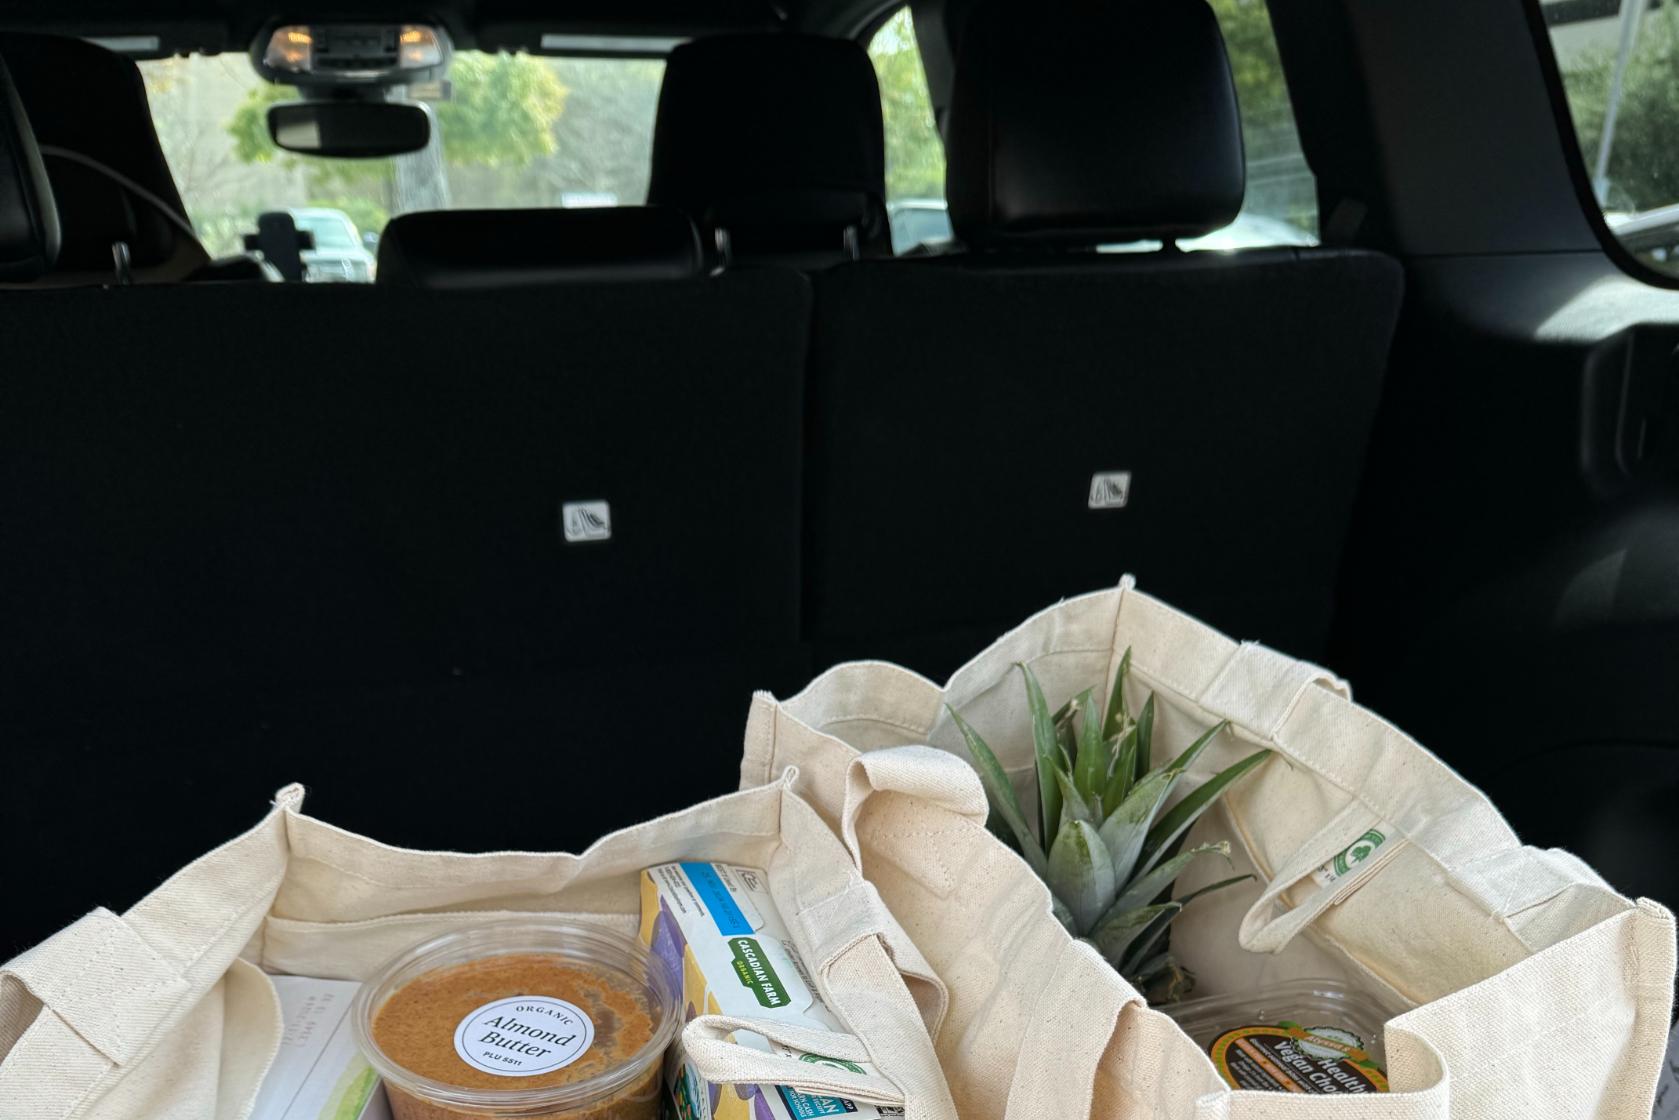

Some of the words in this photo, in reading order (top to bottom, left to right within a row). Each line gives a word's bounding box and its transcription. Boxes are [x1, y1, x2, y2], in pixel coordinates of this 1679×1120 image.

[736, 961, 754, 985] ORGANIC
[738, 940, 769, 981] CASCADIAN
[761, 982, 781, 1005] FARM
[515, 1005, 574, 1026] ORGANIC
[479, 1031, 551, 1058] Butter
[484, 1015, 576, 1046] Almond
[483, 1051, 502, 1060] PLU
[1274, 1040, 1314, 1074] Vegan
[1309, 1071, 1341, 1094] Cho
[1317, 1059, 1368, 1094] Health
